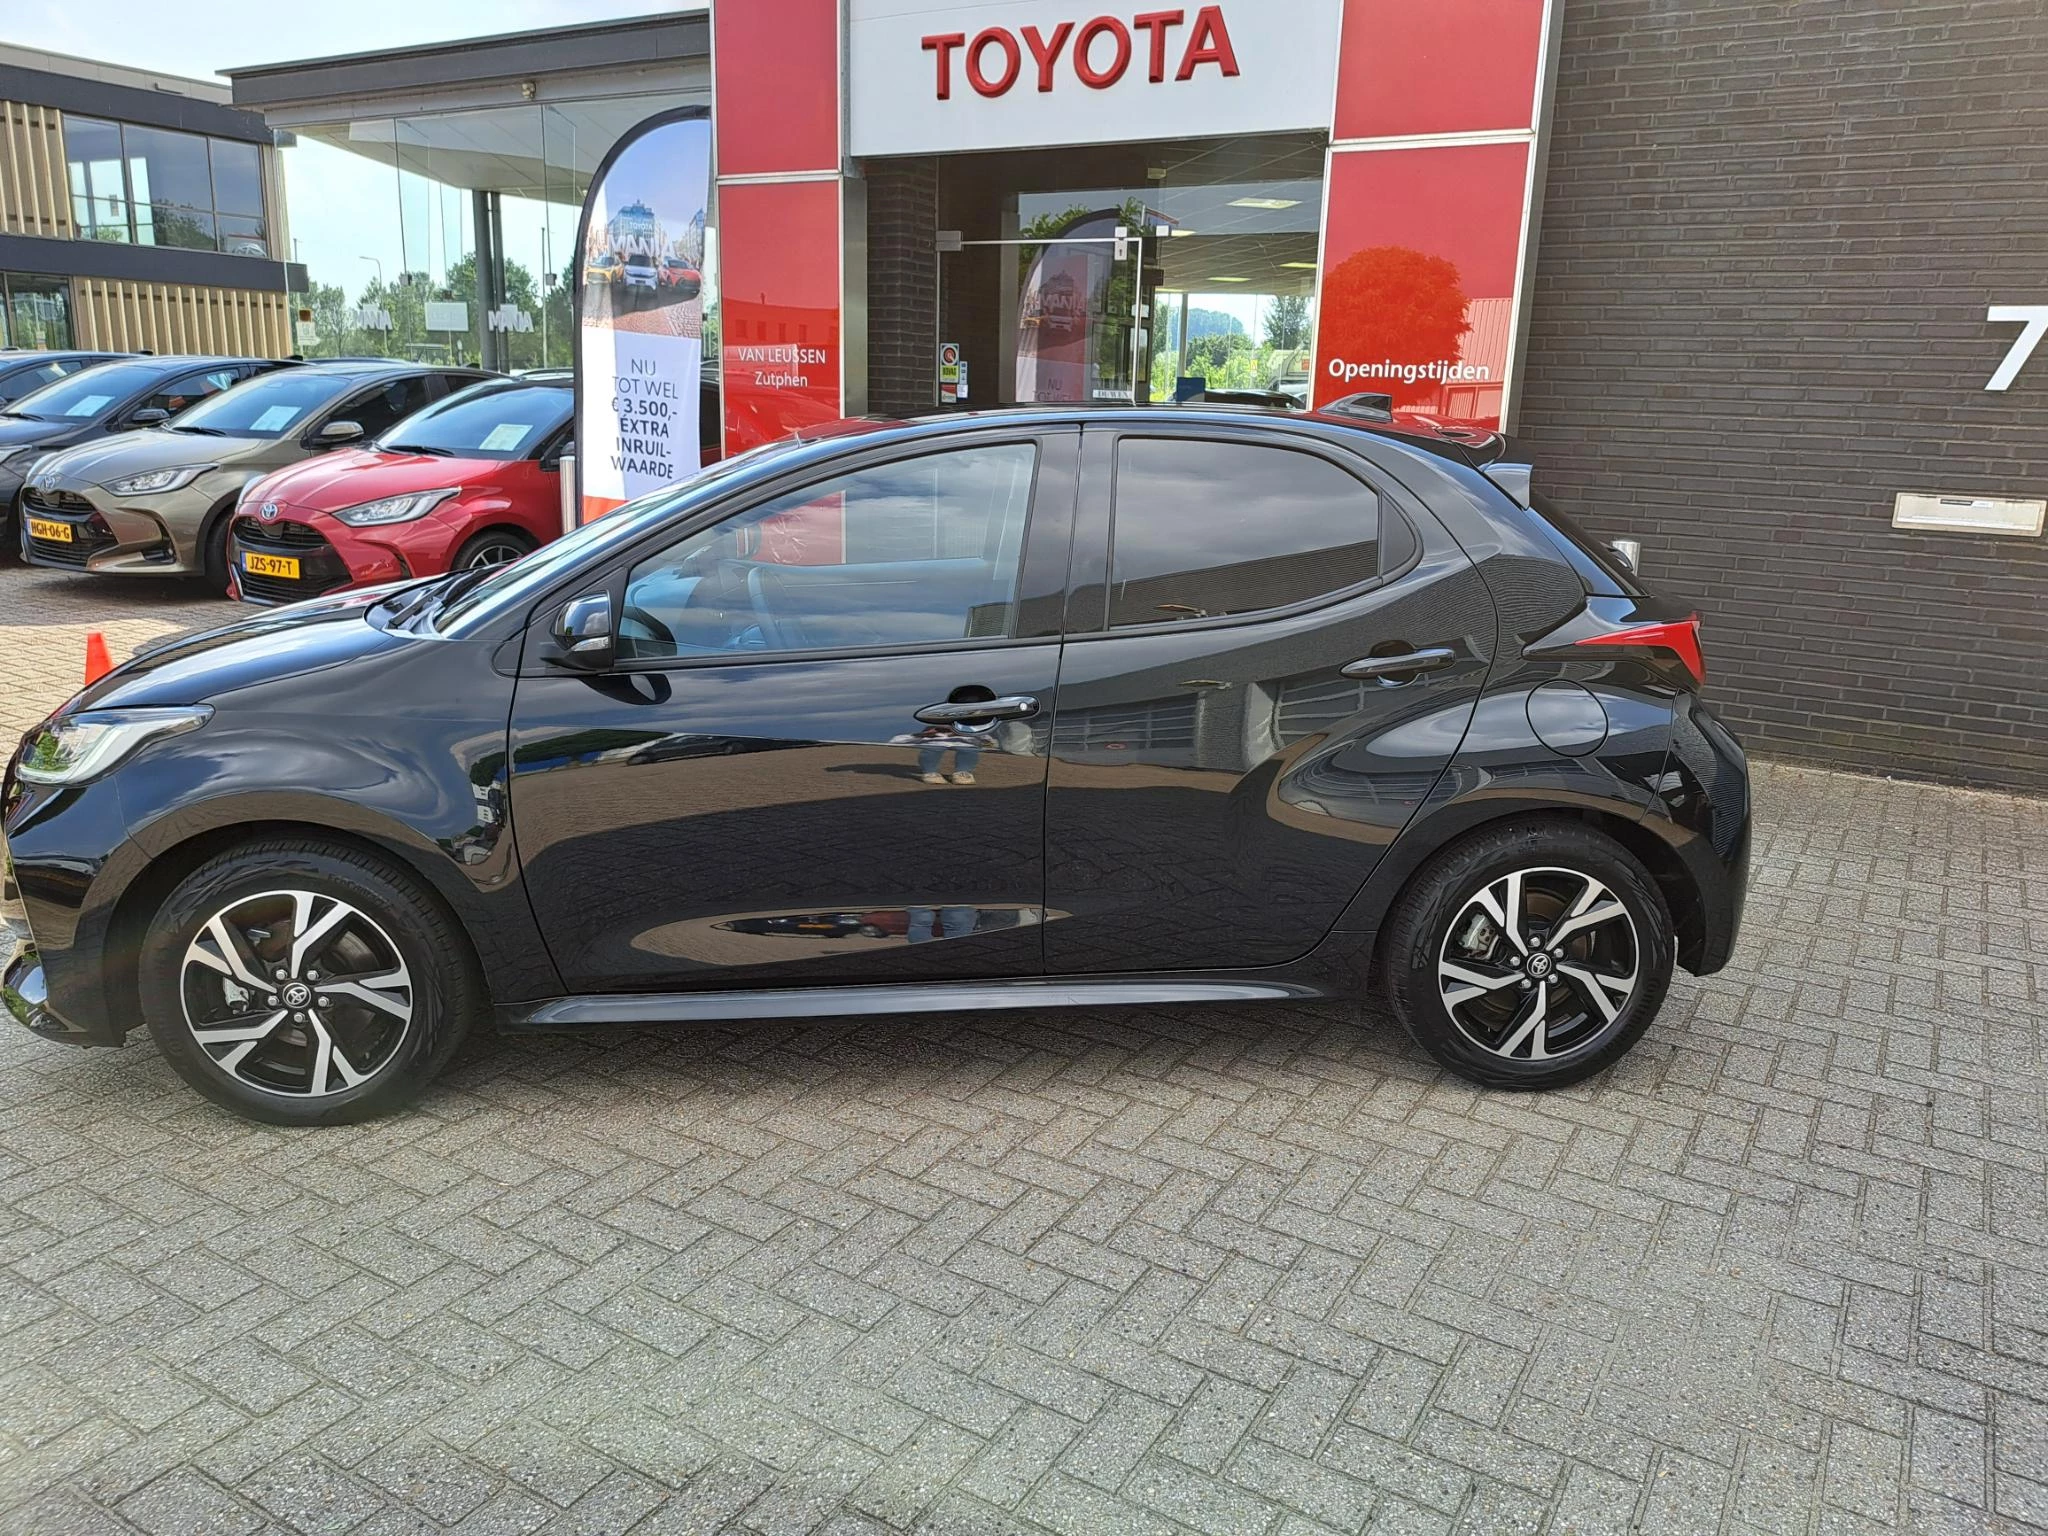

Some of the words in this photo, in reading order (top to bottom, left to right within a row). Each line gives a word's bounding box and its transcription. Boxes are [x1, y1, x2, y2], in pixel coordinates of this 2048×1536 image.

[921, 5, 1240, 100] TOYOTA
[607, 233, 676, 261] MANIA
[738, 347, 764, 361] VAN
[768, 348, 826, 364] LEUSSEN
[1984, 305, 2048, 391] 7
[631, 359, 656, 376] NU
[1328, 358, 1489, 384] Openingstijden
[612, 376, 641, 394] TOT
[644, 380, 679, 400] WEL
[755, 371, 808, 390] Zutphen
[623, 398, 678, 421] 3.500,-
[616, 437, 671, 458] INRUIL-
[610, 455, 674, 479] WAARDE
[30, 521, 70, 539] HGH-06-G
[249, 555, 293, 575] JZS-97-T
